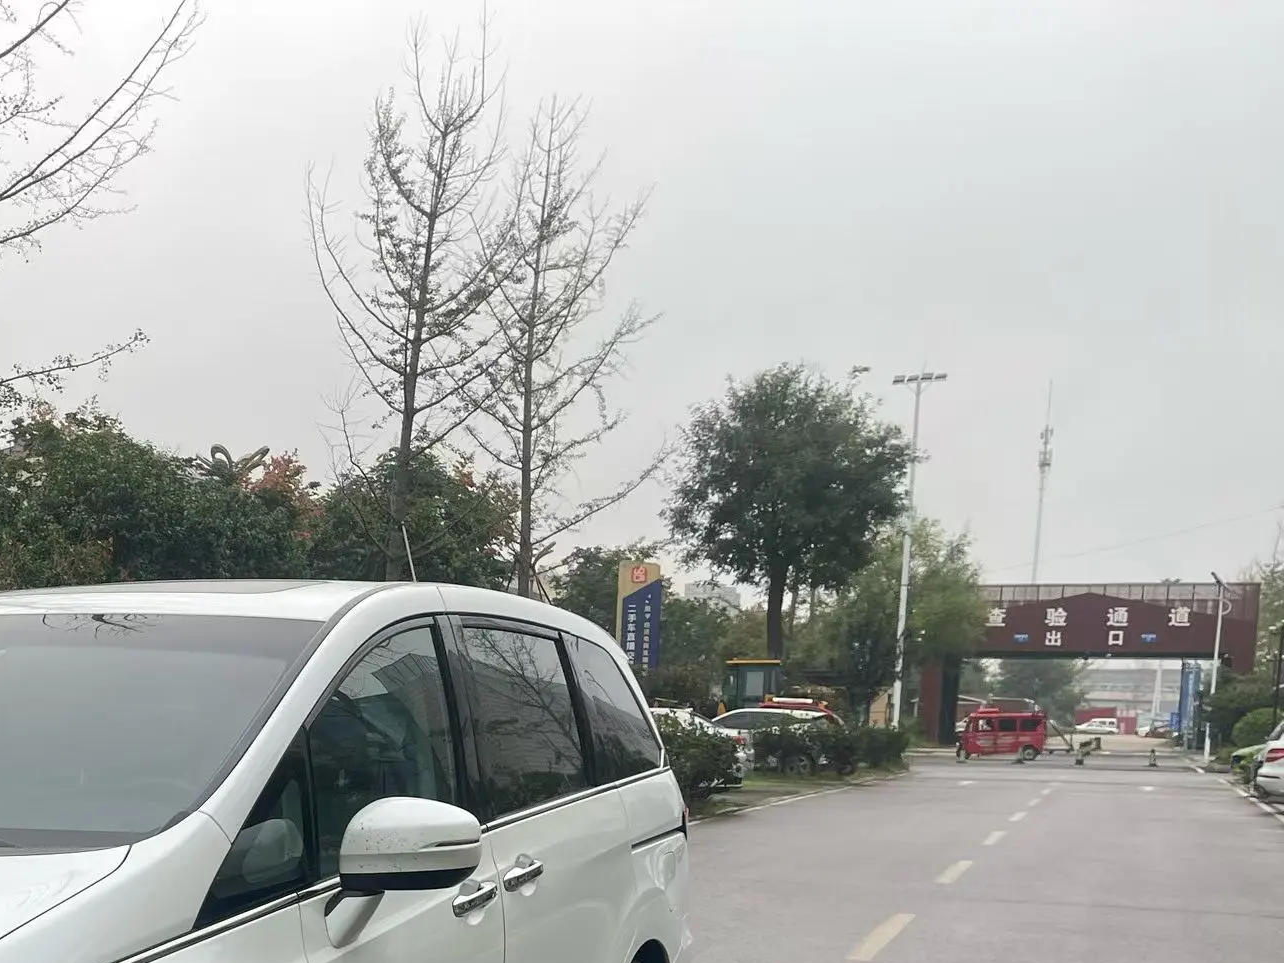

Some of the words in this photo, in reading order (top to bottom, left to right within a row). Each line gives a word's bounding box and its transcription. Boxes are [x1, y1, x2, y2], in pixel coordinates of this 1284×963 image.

[985, 606, 1191, 628] 查验通道
[1045, 631, 1124, 647] 出口
